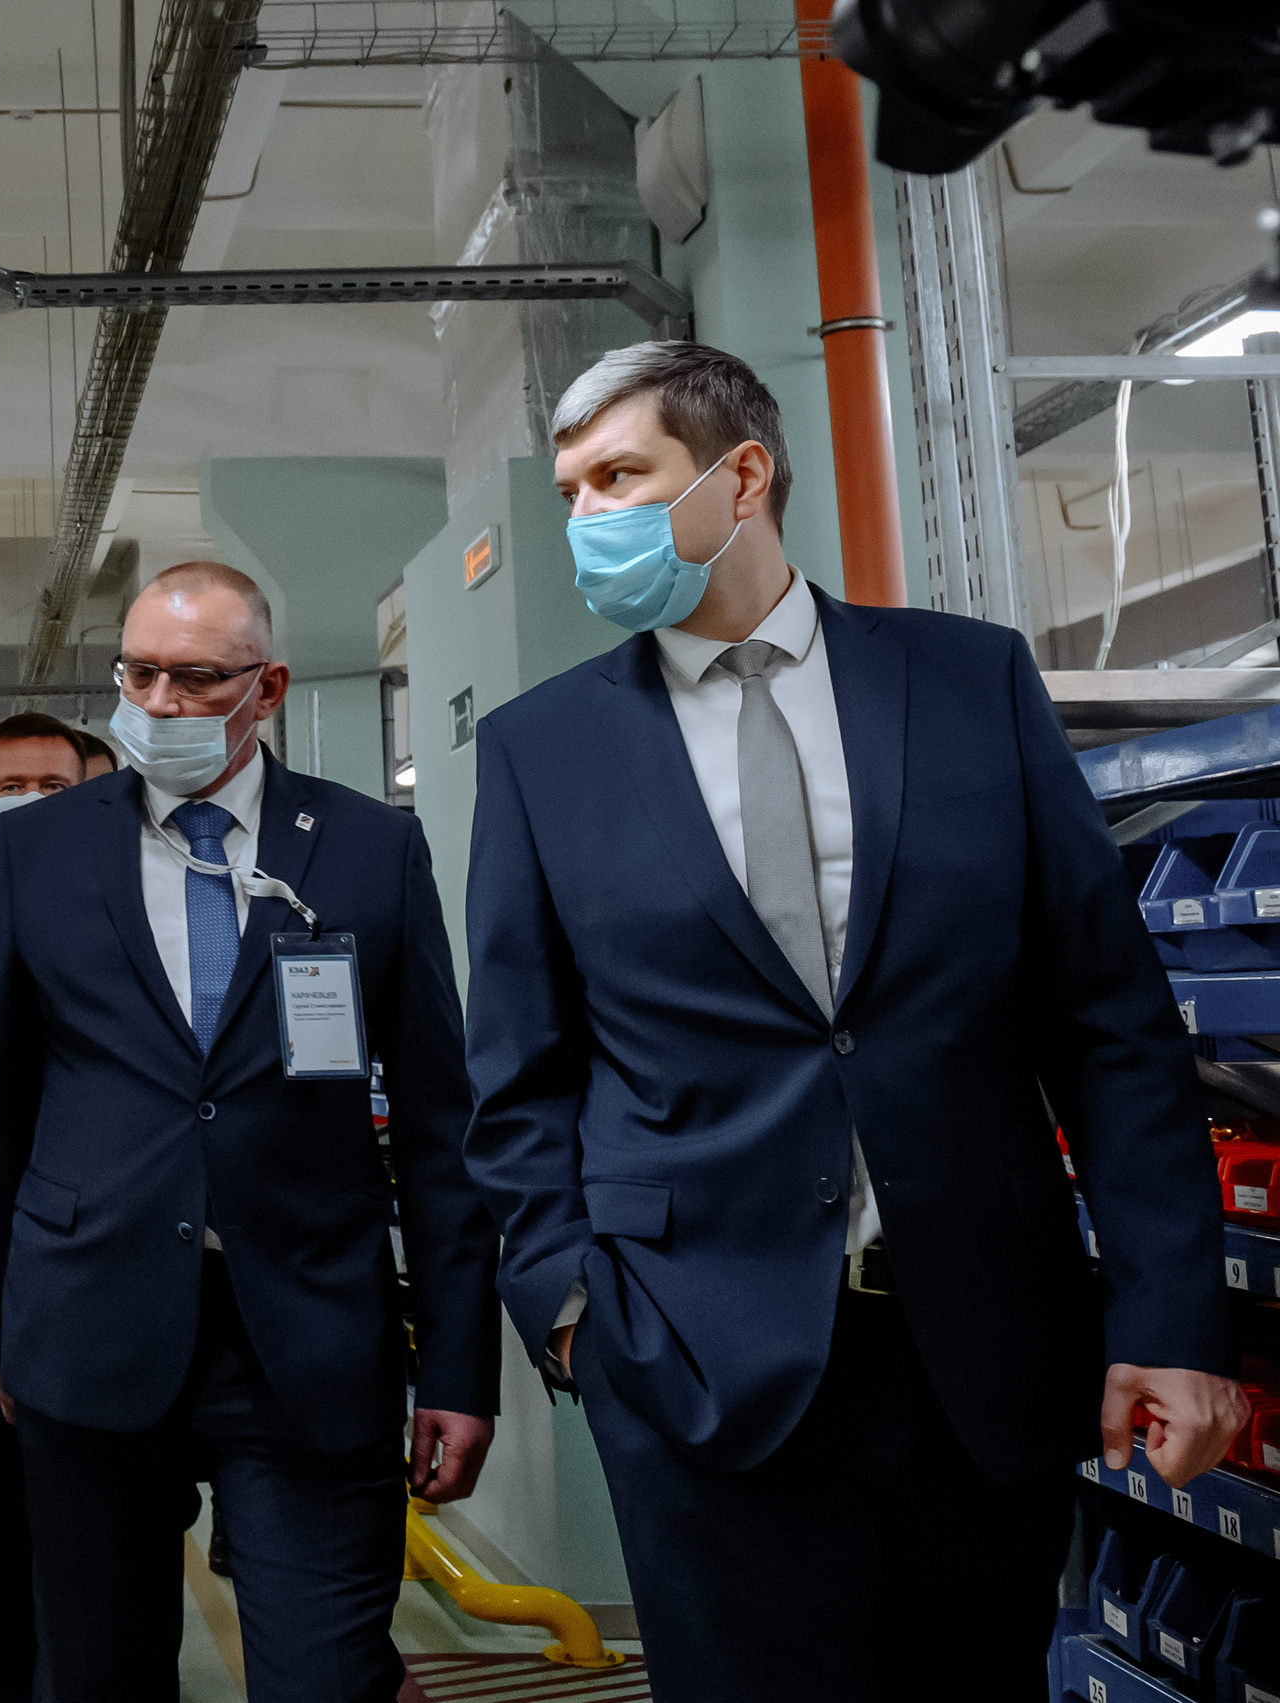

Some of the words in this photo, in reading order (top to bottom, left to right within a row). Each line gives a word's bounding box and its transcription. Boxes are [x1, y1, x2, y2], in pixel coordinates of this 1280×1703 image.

[1232, 1262, 1240, 1284] 9
[1085, 1459, 1097, 1478] 15
[1131, 1476, 1144, 1498] 16
[1176, 1494, 1189, 1517] 17
[1223, 1514, 1238, 1539] 18
[1091, 1681, 1105, 1703] 25
